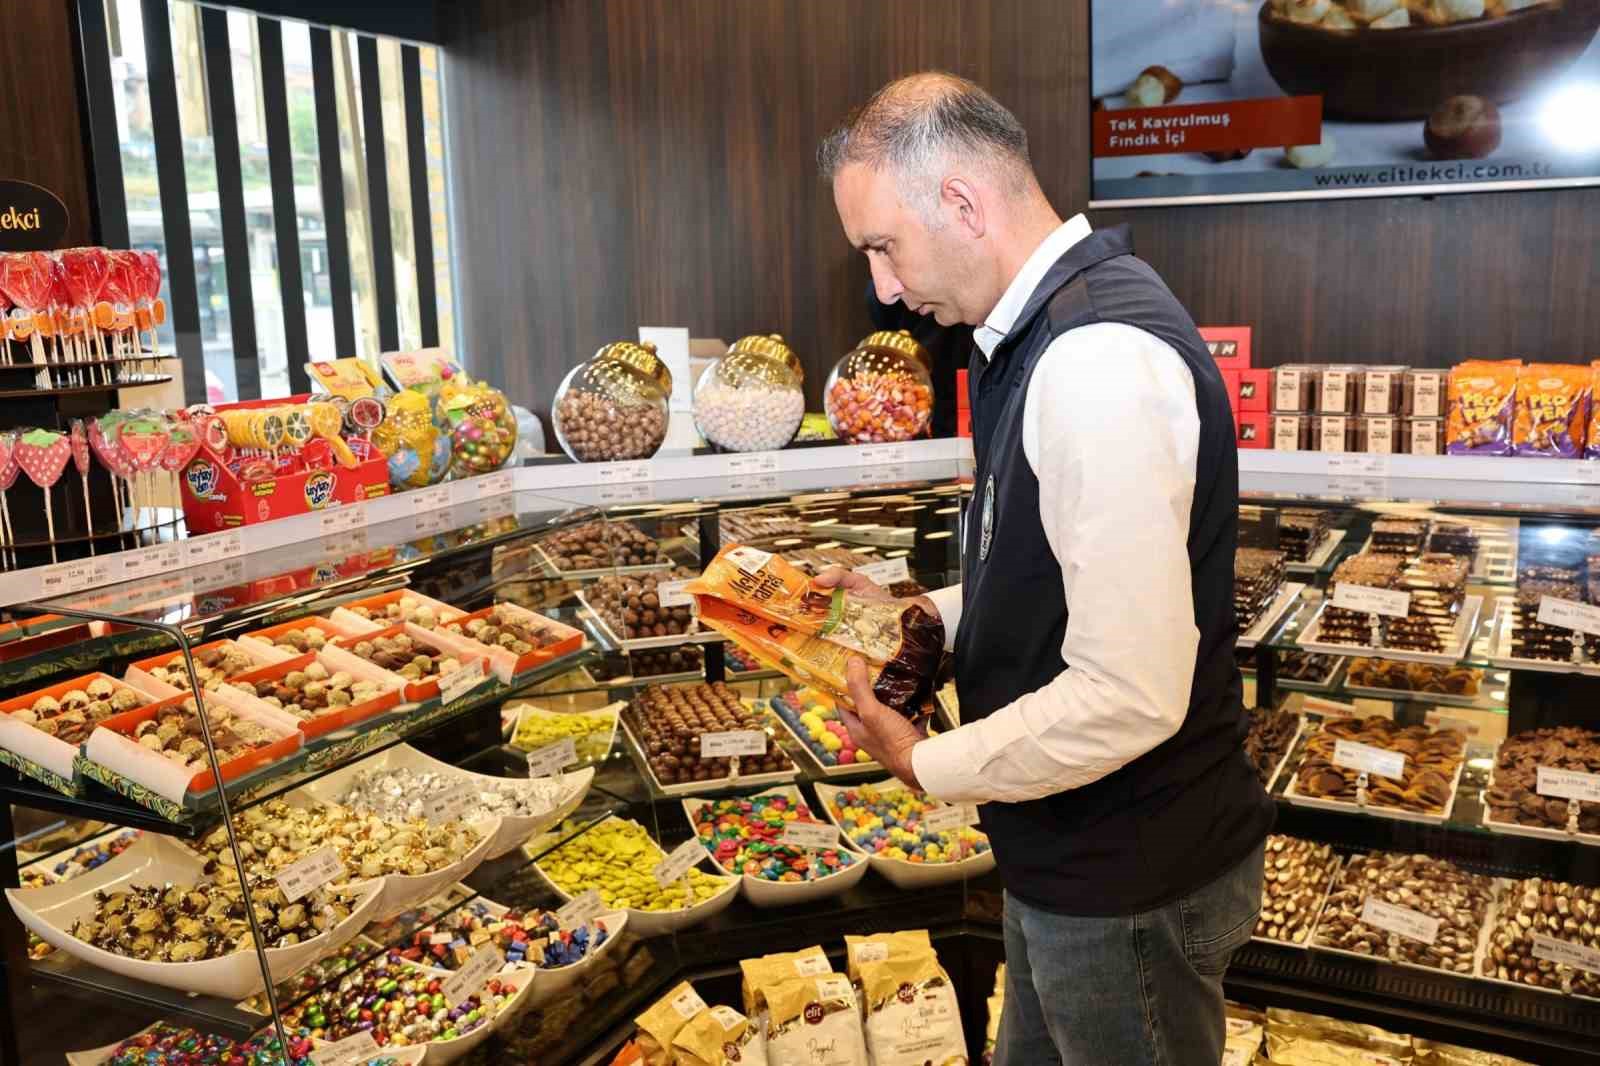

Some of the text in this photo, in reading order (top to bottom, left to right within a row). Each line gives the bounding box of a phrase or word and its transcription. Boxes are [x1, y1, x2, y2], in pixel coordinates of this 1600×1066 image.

[1110, 113, 1231, 131] Tek Kavrulmuş
[1110, 133, 1160, 147] Fındık
[805, 1005, 821, 1019] elit
